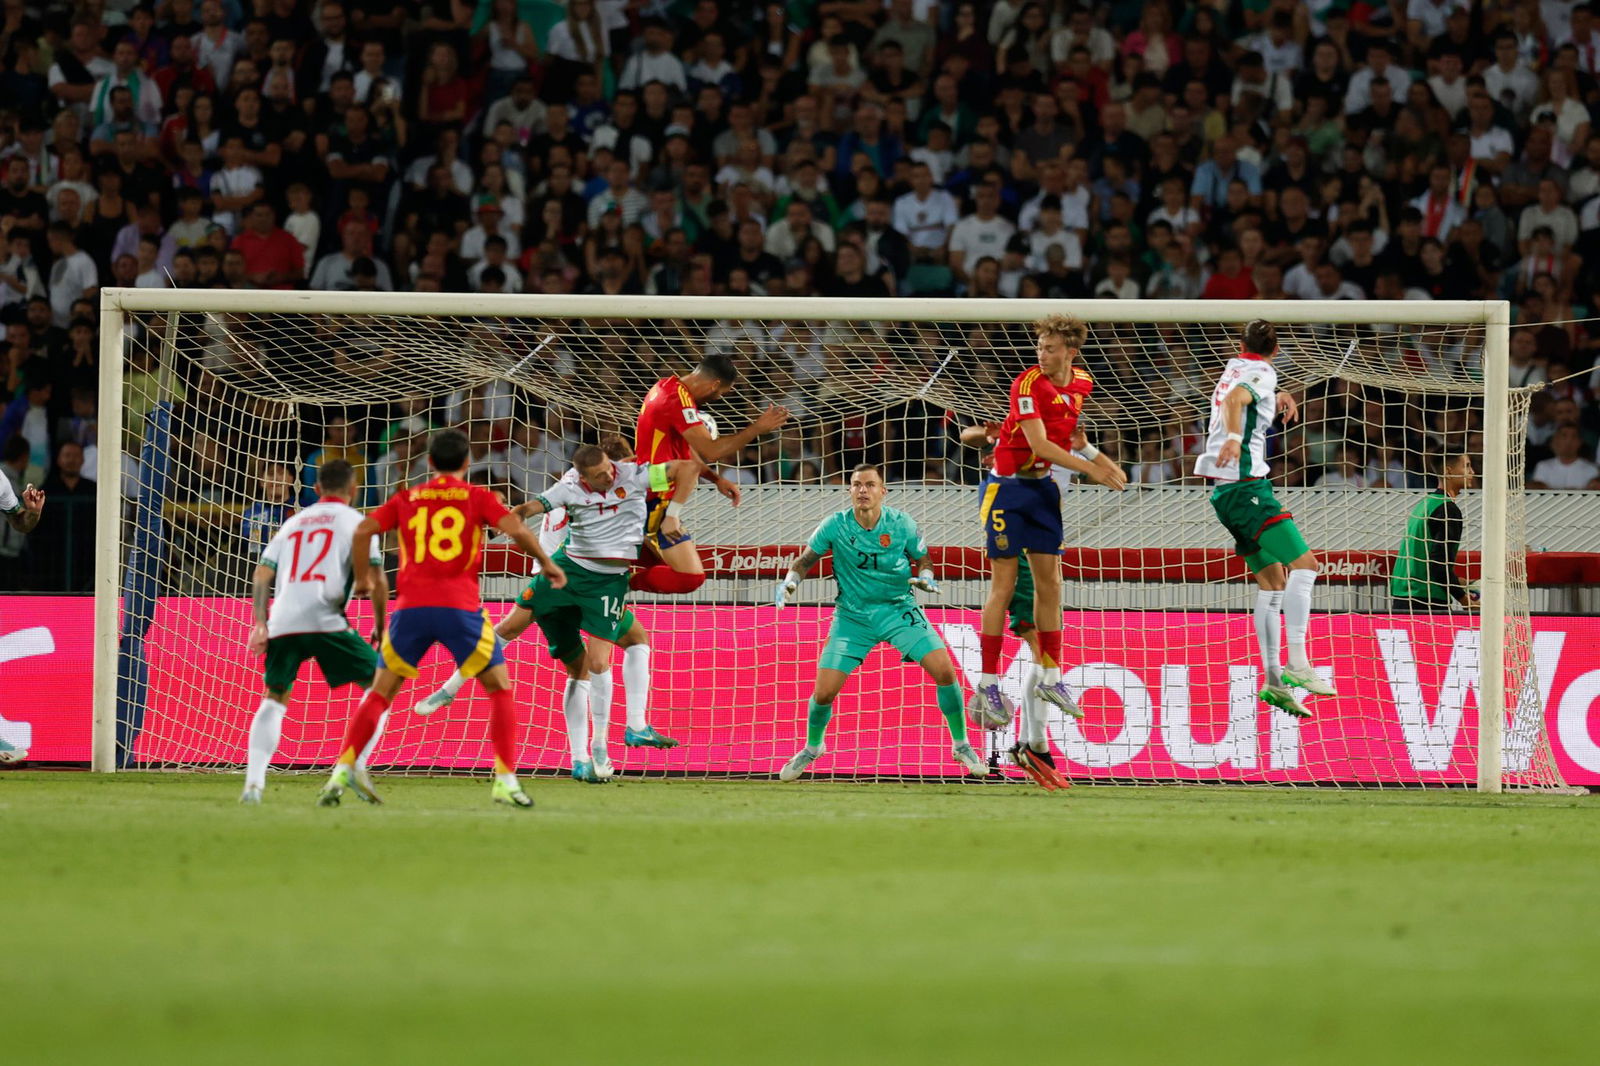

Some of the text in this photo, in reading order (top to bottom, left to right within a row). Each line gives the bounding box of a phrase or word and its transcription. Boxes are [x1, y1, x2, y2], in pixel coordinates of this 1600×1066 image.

[992, 509, 1007, 532] 5
[408, 505, 465, 564] 18
[288, 527, 334, 583] 12
[857, 551, 878, 570] 21
[601, 595, 621, 621] 14
[902, 606, 927, 627] 21
